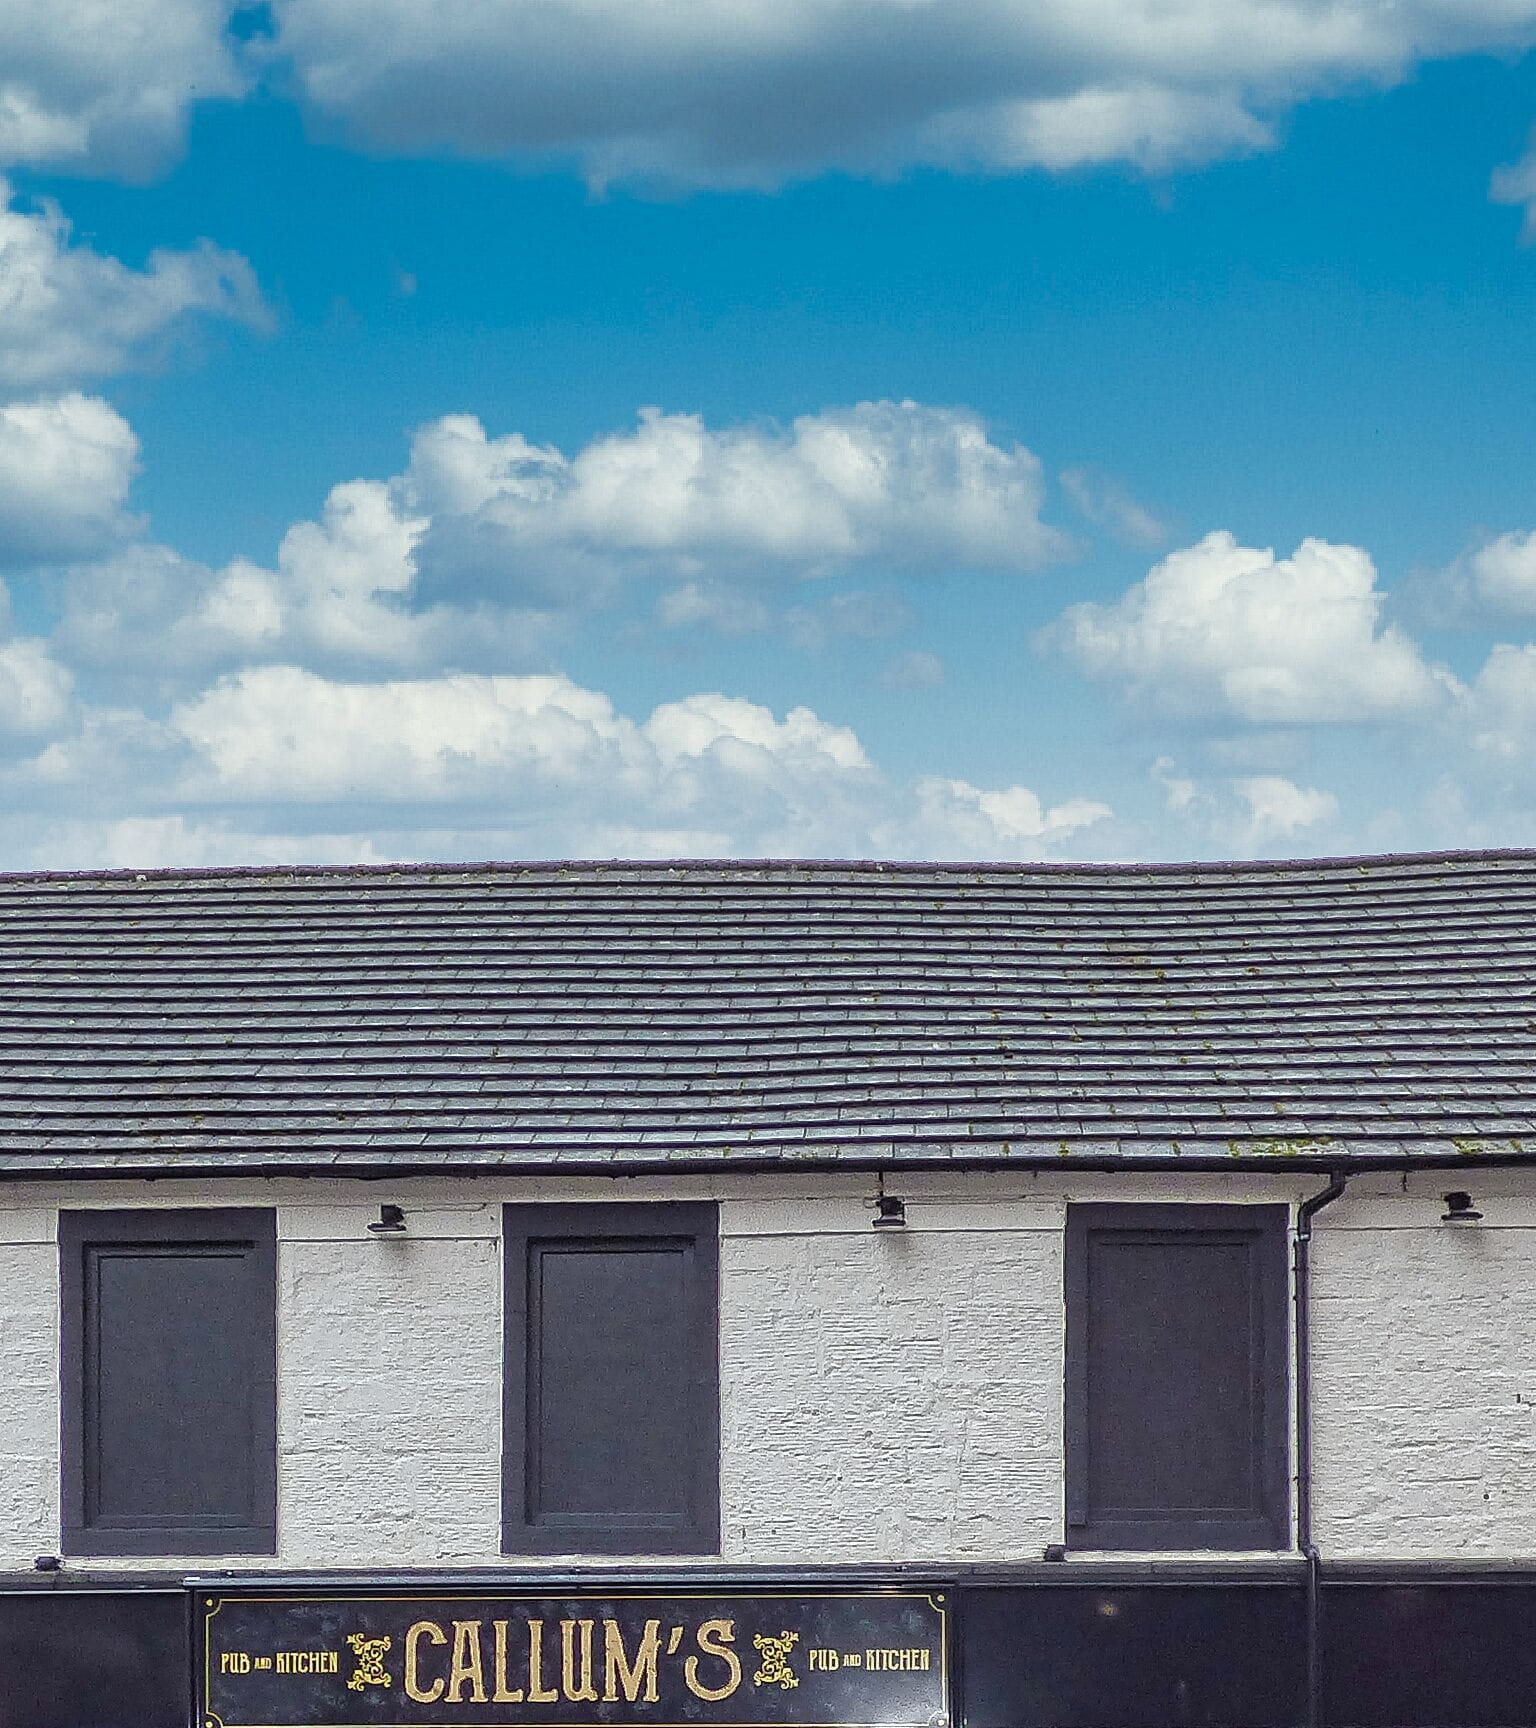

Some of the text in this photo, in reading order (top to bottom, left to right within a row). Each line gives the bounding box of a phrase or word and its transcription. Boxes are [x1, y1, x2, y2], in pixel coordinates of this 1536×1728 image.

[220, 1652, 339, 1674] PUB AND KITCHEN
[404, 1619, 742, 1703] CALLUM'S
[809, 1649, 930, 1671] PUB AND KITCHEN
